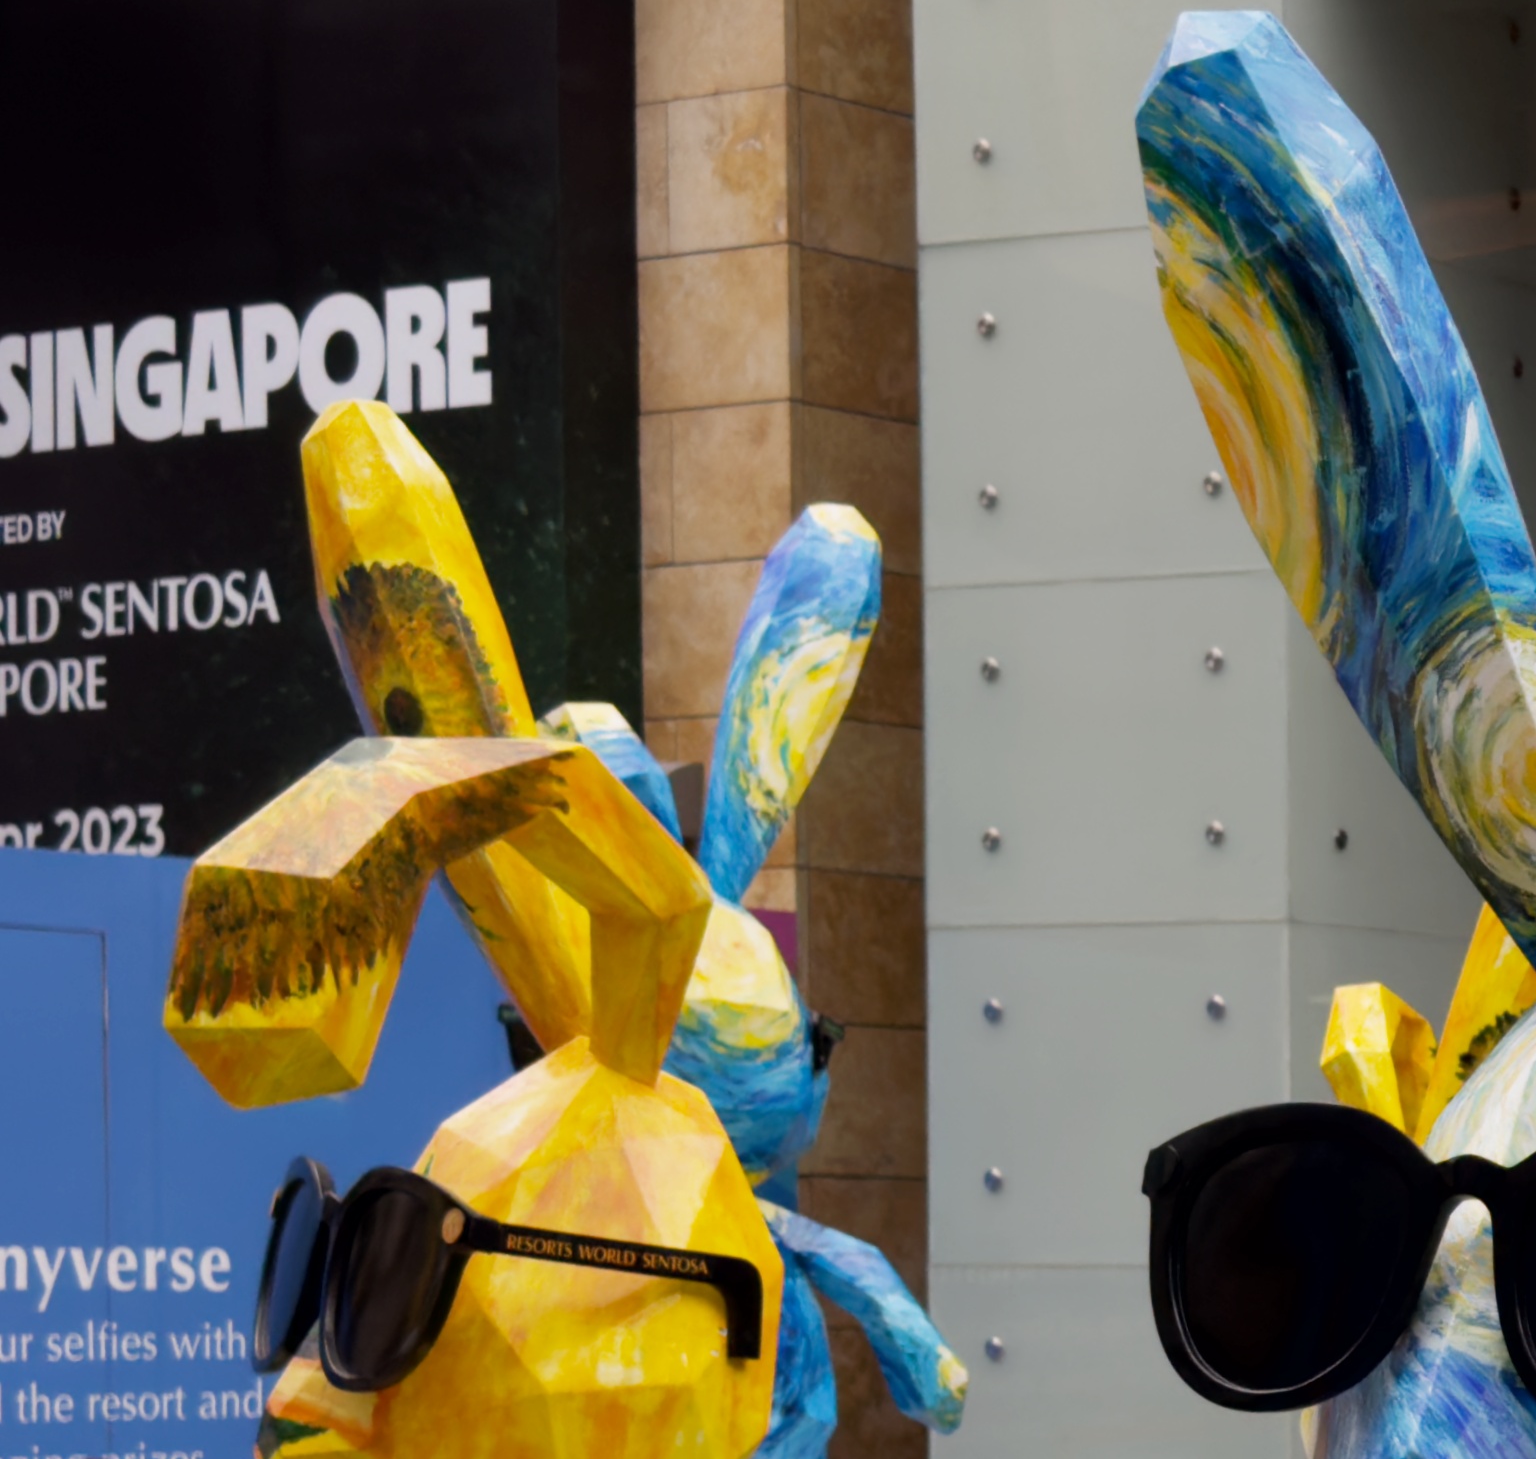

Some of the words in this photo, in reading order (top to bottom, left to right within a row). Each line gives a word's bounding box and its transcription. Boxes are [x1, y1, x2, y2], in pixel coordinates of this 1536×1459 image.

[0, 277, 494, 457] SINGAPORE
[0, 512, 33, 545] ED
[37, 509, 66, 541] BY
[80, 569, 281, 640] SENTOSA
[0, 656, 107, 718] PORE
[54, 803, 166, 858] 2023
[506, 1233, 573, 1258] RESORTS
[578, 1243, 637, 1267] WORLD
[642, 1251, 709, 1275] SENTOSA
[46, 1318, 158, 1362] selfies
[168, 1318, 247, 1361] with
[17, 1381, 75, 1424] the
[88, 1385, 187, 1421] resort
[199, 1376, 264, 1420] and
